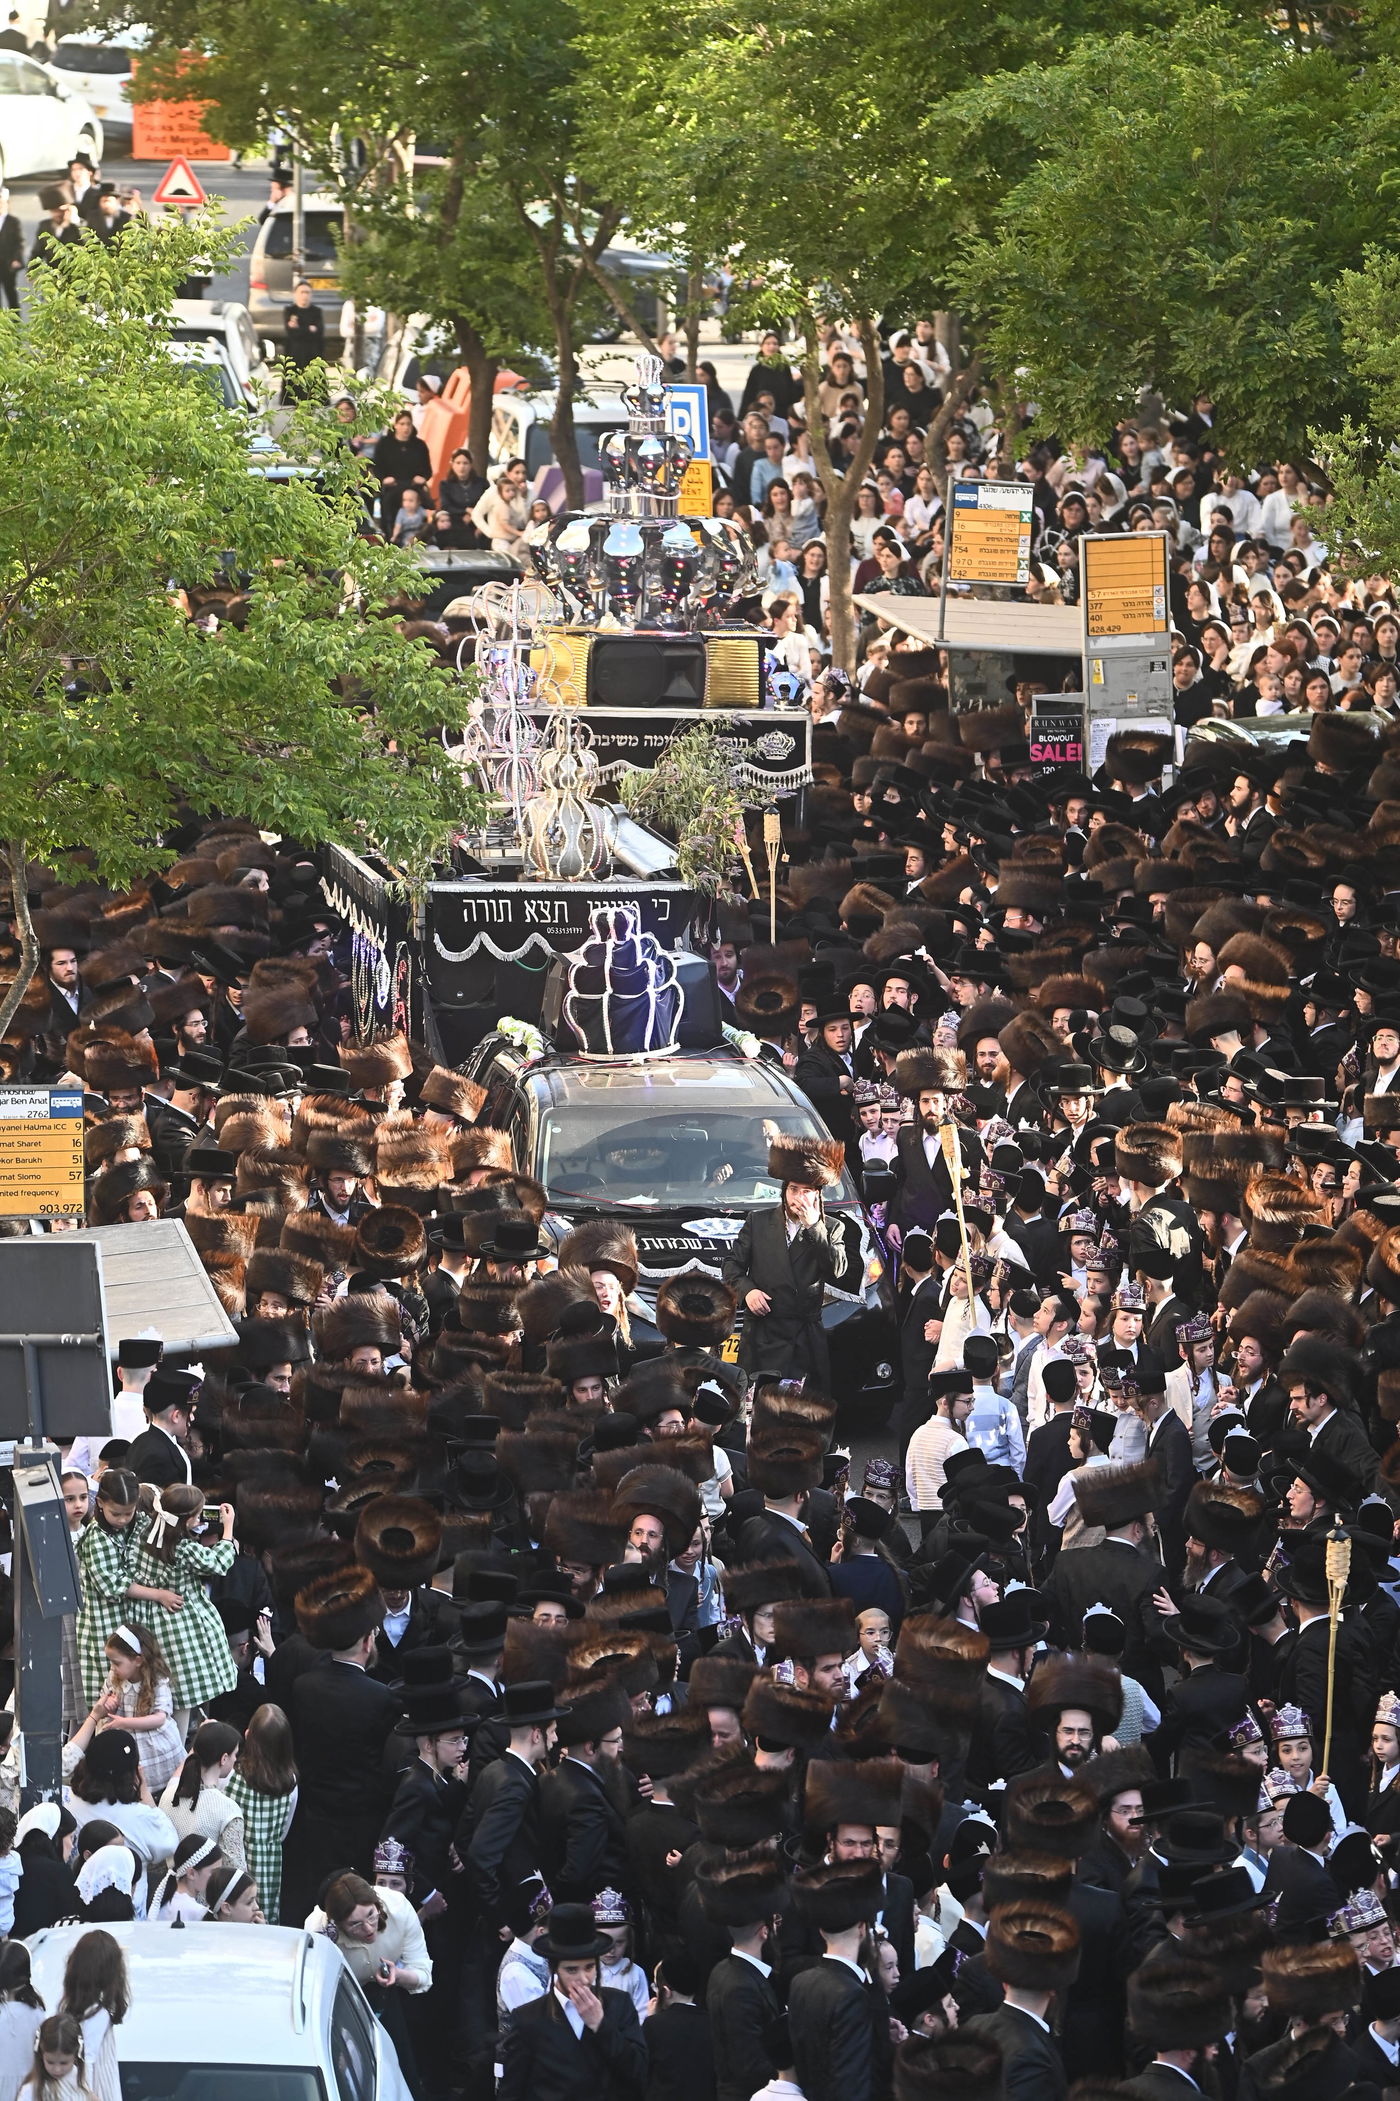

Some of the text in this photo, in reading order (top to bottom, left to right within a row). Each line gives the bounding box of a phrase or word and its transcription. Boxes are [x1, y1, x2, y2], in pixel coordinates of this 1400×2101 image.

[957, 522, 966, 530] 16
[955, 558, 973, 566] 970
[952, 569, 968, 577] 742
[1089, 602, 1104, 610] 377
[1089, 614, 1103, 622] 401
[1034, 719, 1080, 727] RUNWAY
[590, 734, 639, 748] משיבת
[1038, 734, 1075, 743] BLOWOUT
[1030, 743, 1083, 762] SALE!
[462, 898, 513, 924] תורה
[523, 899, 570, 924] תצא
[651, 898, 671, 922] כי
[11, 1097, 28, 1105] Ben
[29, 1097, 48, 1105] Anat
[27, 1110, 49, 1119] 2762
[23, 1123, 52, 1131] HaUma
[75, 1121, 82, 1131] 9
[16, 1140, 42, 1148] Sharet
[72, 1138, 82, 1148] 16
[15, 1156, 43, 1164] Barukh
[72, 1154, 82, 1164] 51
[68, 1171, 82, 1181] 57
[20, 1189, 60, 1198] frequency
[640, 1237, 718, 1251] בשמחת
